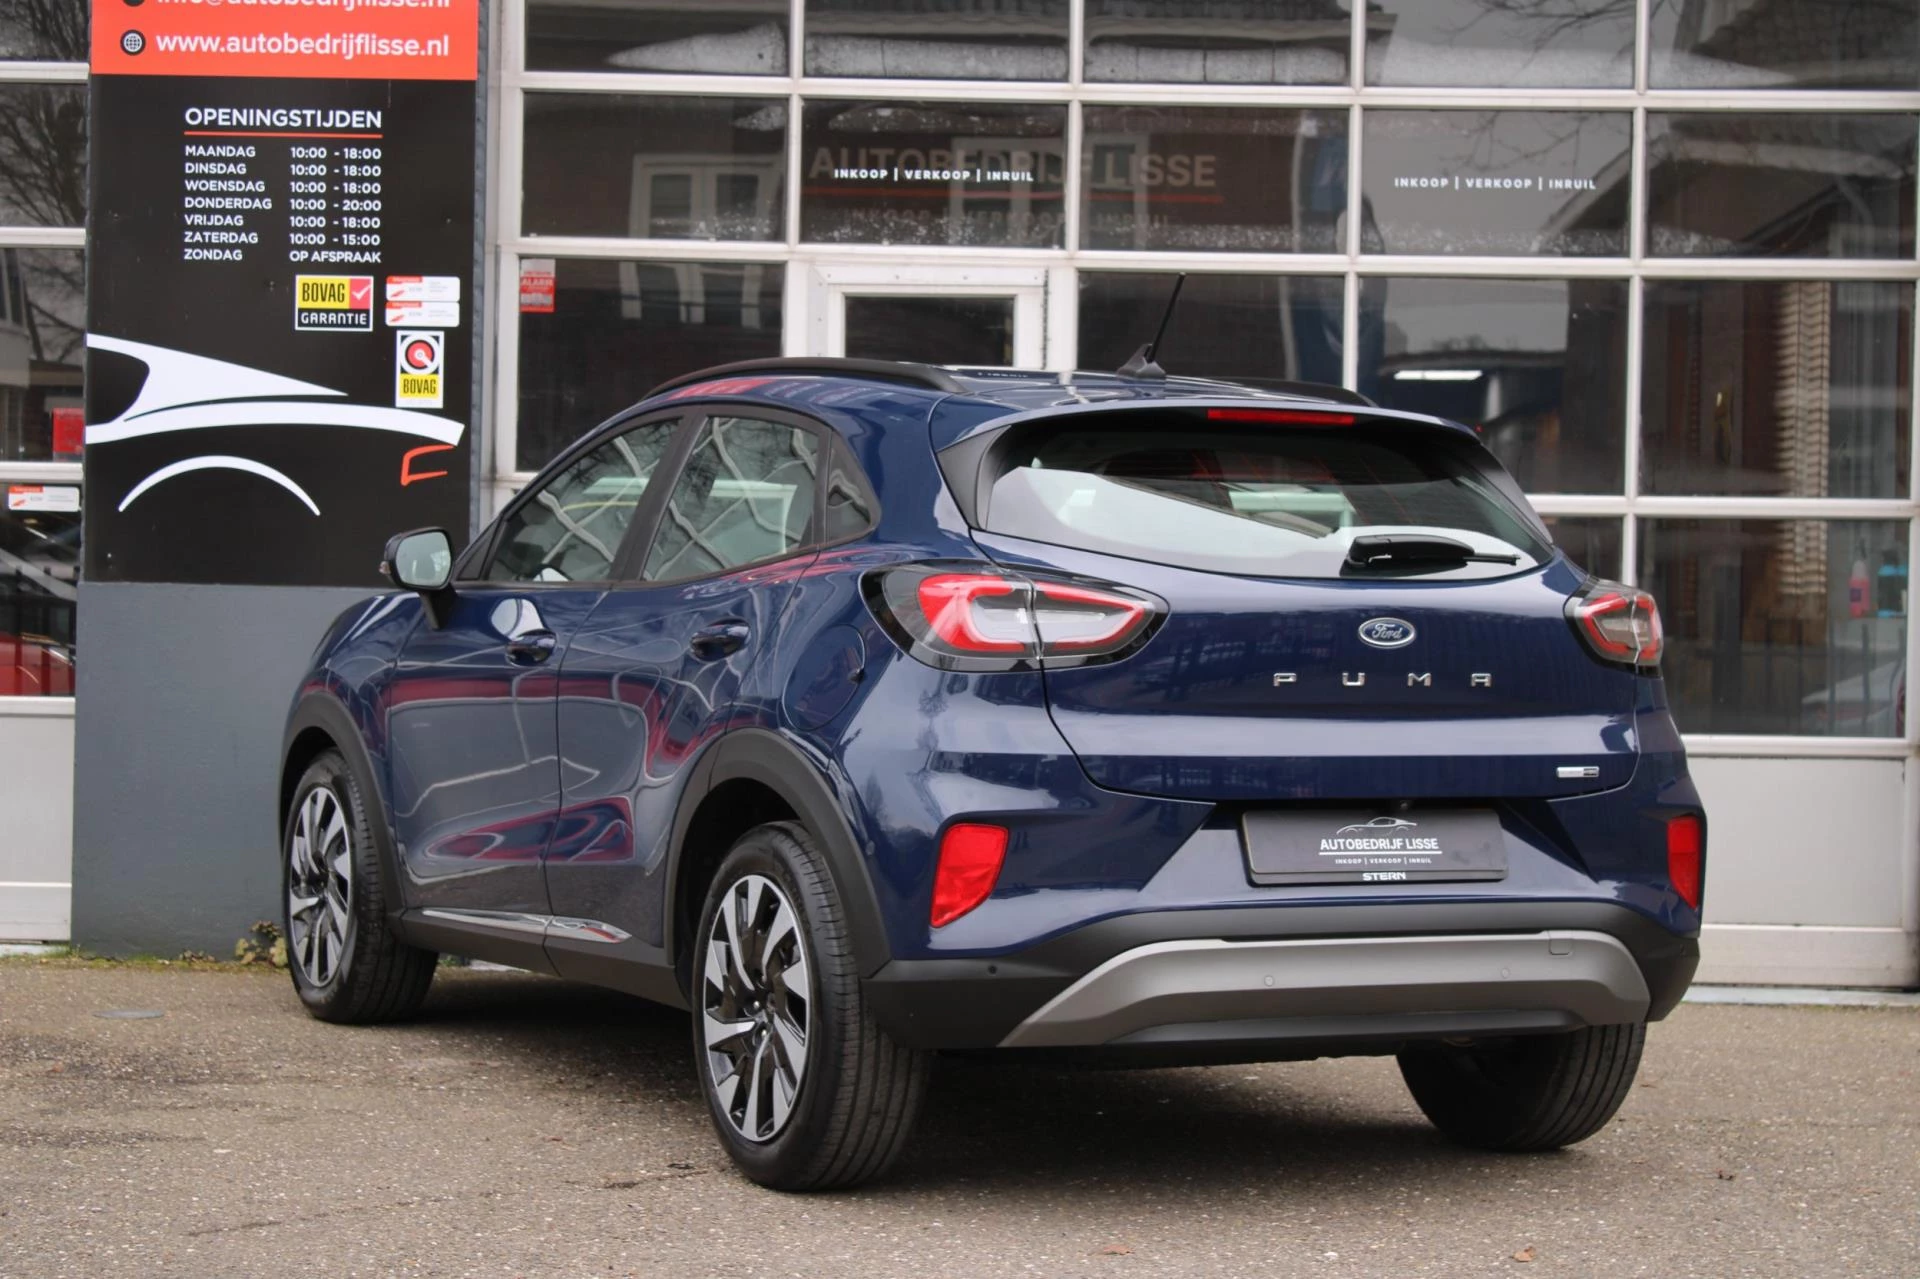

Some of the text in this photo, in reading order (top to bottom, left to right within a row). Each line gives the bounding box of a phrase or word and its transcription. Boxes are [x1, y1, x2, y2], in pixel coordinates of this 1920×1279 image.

[156, 33, 448, 59] www.autobedrijflisse.nl
[185, 108, 381, 128] OPENINGSTIJDEN
[186, 145, 255, 157] MAANDAG
[291, 147, 327, 158] 10:00
[344, 148, 381, 159] 18:00
[185, 162, 246, 174] DINSDAG
[291, 164, 326, 175] 10:00
[344, 165, 381, 176] 18:00
[835, 169, 887, 178] INKOOP
[905, 170, 970, 180] VERKOOP
[987, 171, 1033, 181] INRUIL
[1105, 152, 1217, 188] LISSE
[185, 180, 265, 192] WOENSDAG
[290, 182, 326, 193] 10:00
[343, 182, 381, 194] 18:00
[1395, 178, 1448, 187] INKOOP
[1466, 179, 1531, 188] VERKOOP
[1549, 178, 1596, 189] INRUIL
[185, 197, 272, 209] DONDERDAG
[290, 199, 326, 210] 10:00
[343, 200, 381, 211] 20:00
[185, 214, 243, 226] VRIJDAG
[290, 216, 326, 227] 10:00
[343, 217, 380, 228] 18:00
[184, 231, 258, 243] ZATERDAG
[290, 233, 325, 244] 10:00
[343, 234, 380, 245] 15:00
[184, 249, 381, 263] ZONDAG OP AFSPRAAK
[302, 283, 345, 302] BOVAG
[301, 313, 366, 324] GARANTIE
[403, 379, 437, 394] BOVAG
[1371, 623, 1402, 639] Ford
[1274, 673, 1491, 686] PUMA
[1320, 838, 1439, 850] AUTOBEDRIJF LISSE
[1362, 872, 1407, 881] STERN
